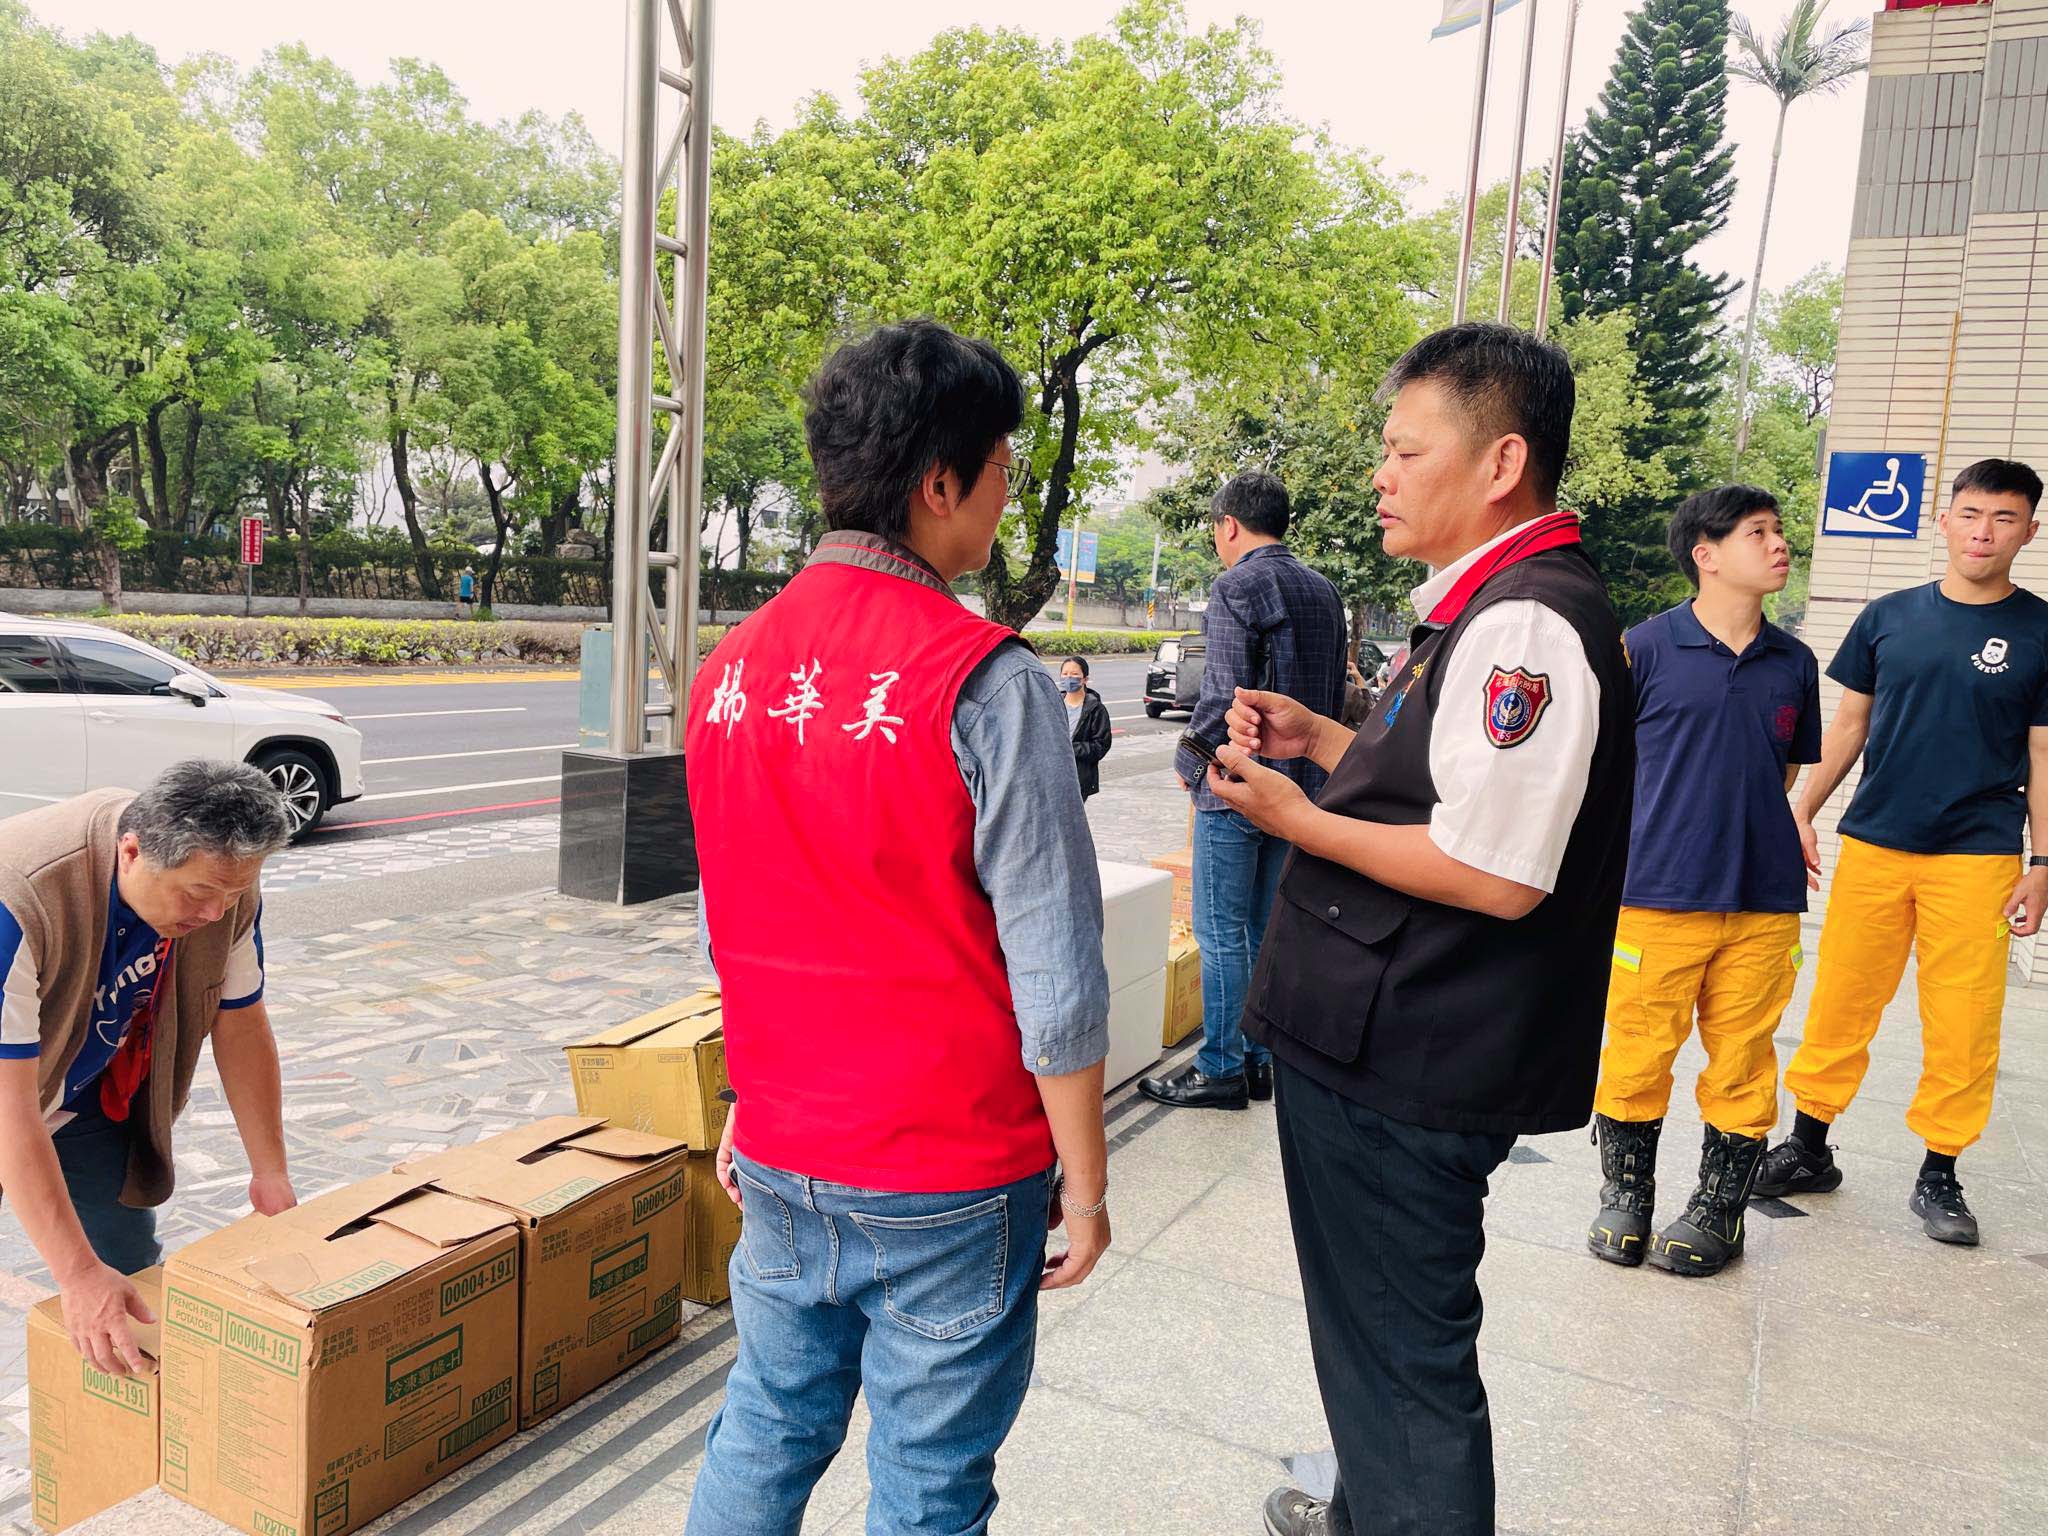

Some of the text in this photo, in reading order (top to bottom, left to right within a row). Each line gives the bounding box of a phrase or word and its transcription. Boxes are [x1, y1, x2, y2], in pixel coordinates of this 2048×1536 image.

[1971, 653, 2009, 674] WORKOUT
[636, 1179, 682, 1217] 00004-191
[445, 1256, 512, 1307] 00004-191
[170, 1294, 220, 1322] FRENCH FRIED
[176, 1309, 213, 1333] POTATOES
[229, 1321, 294, 1367] 00004-191
[86, 1367, 145, 1408] 00004-191
[474, 1378, 511, 1413] M2205
